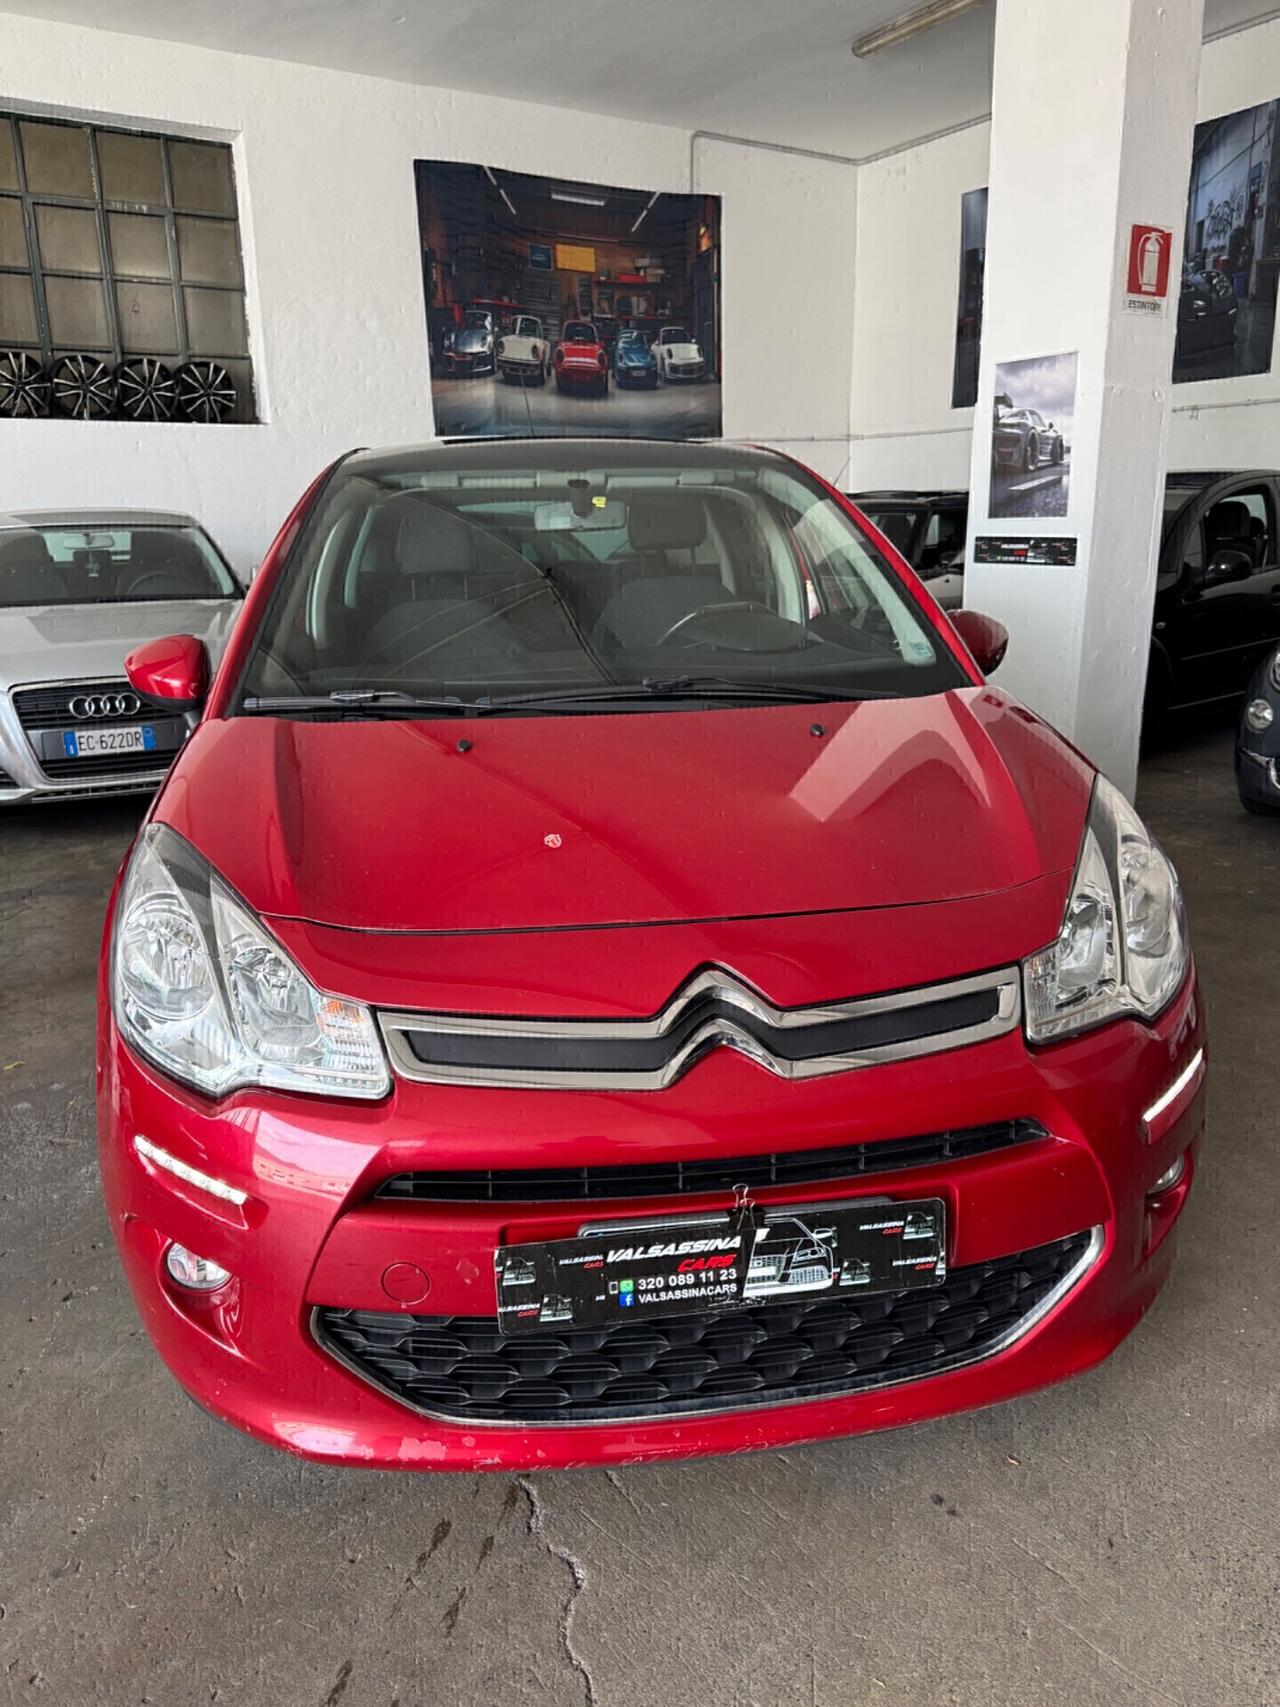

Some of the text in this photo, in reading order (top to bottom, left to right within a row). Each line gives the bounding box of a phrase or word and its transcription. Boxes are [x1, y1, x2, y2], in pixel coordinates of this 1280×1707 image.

[607, 1236, 741, 1262] VALSASSINA
[677, 1254, 737, 1272] CARS
[638, 1268, 737, 1290] 320 089 11 23
[638, 1283, 737, 1303] VALSASSINACARS
